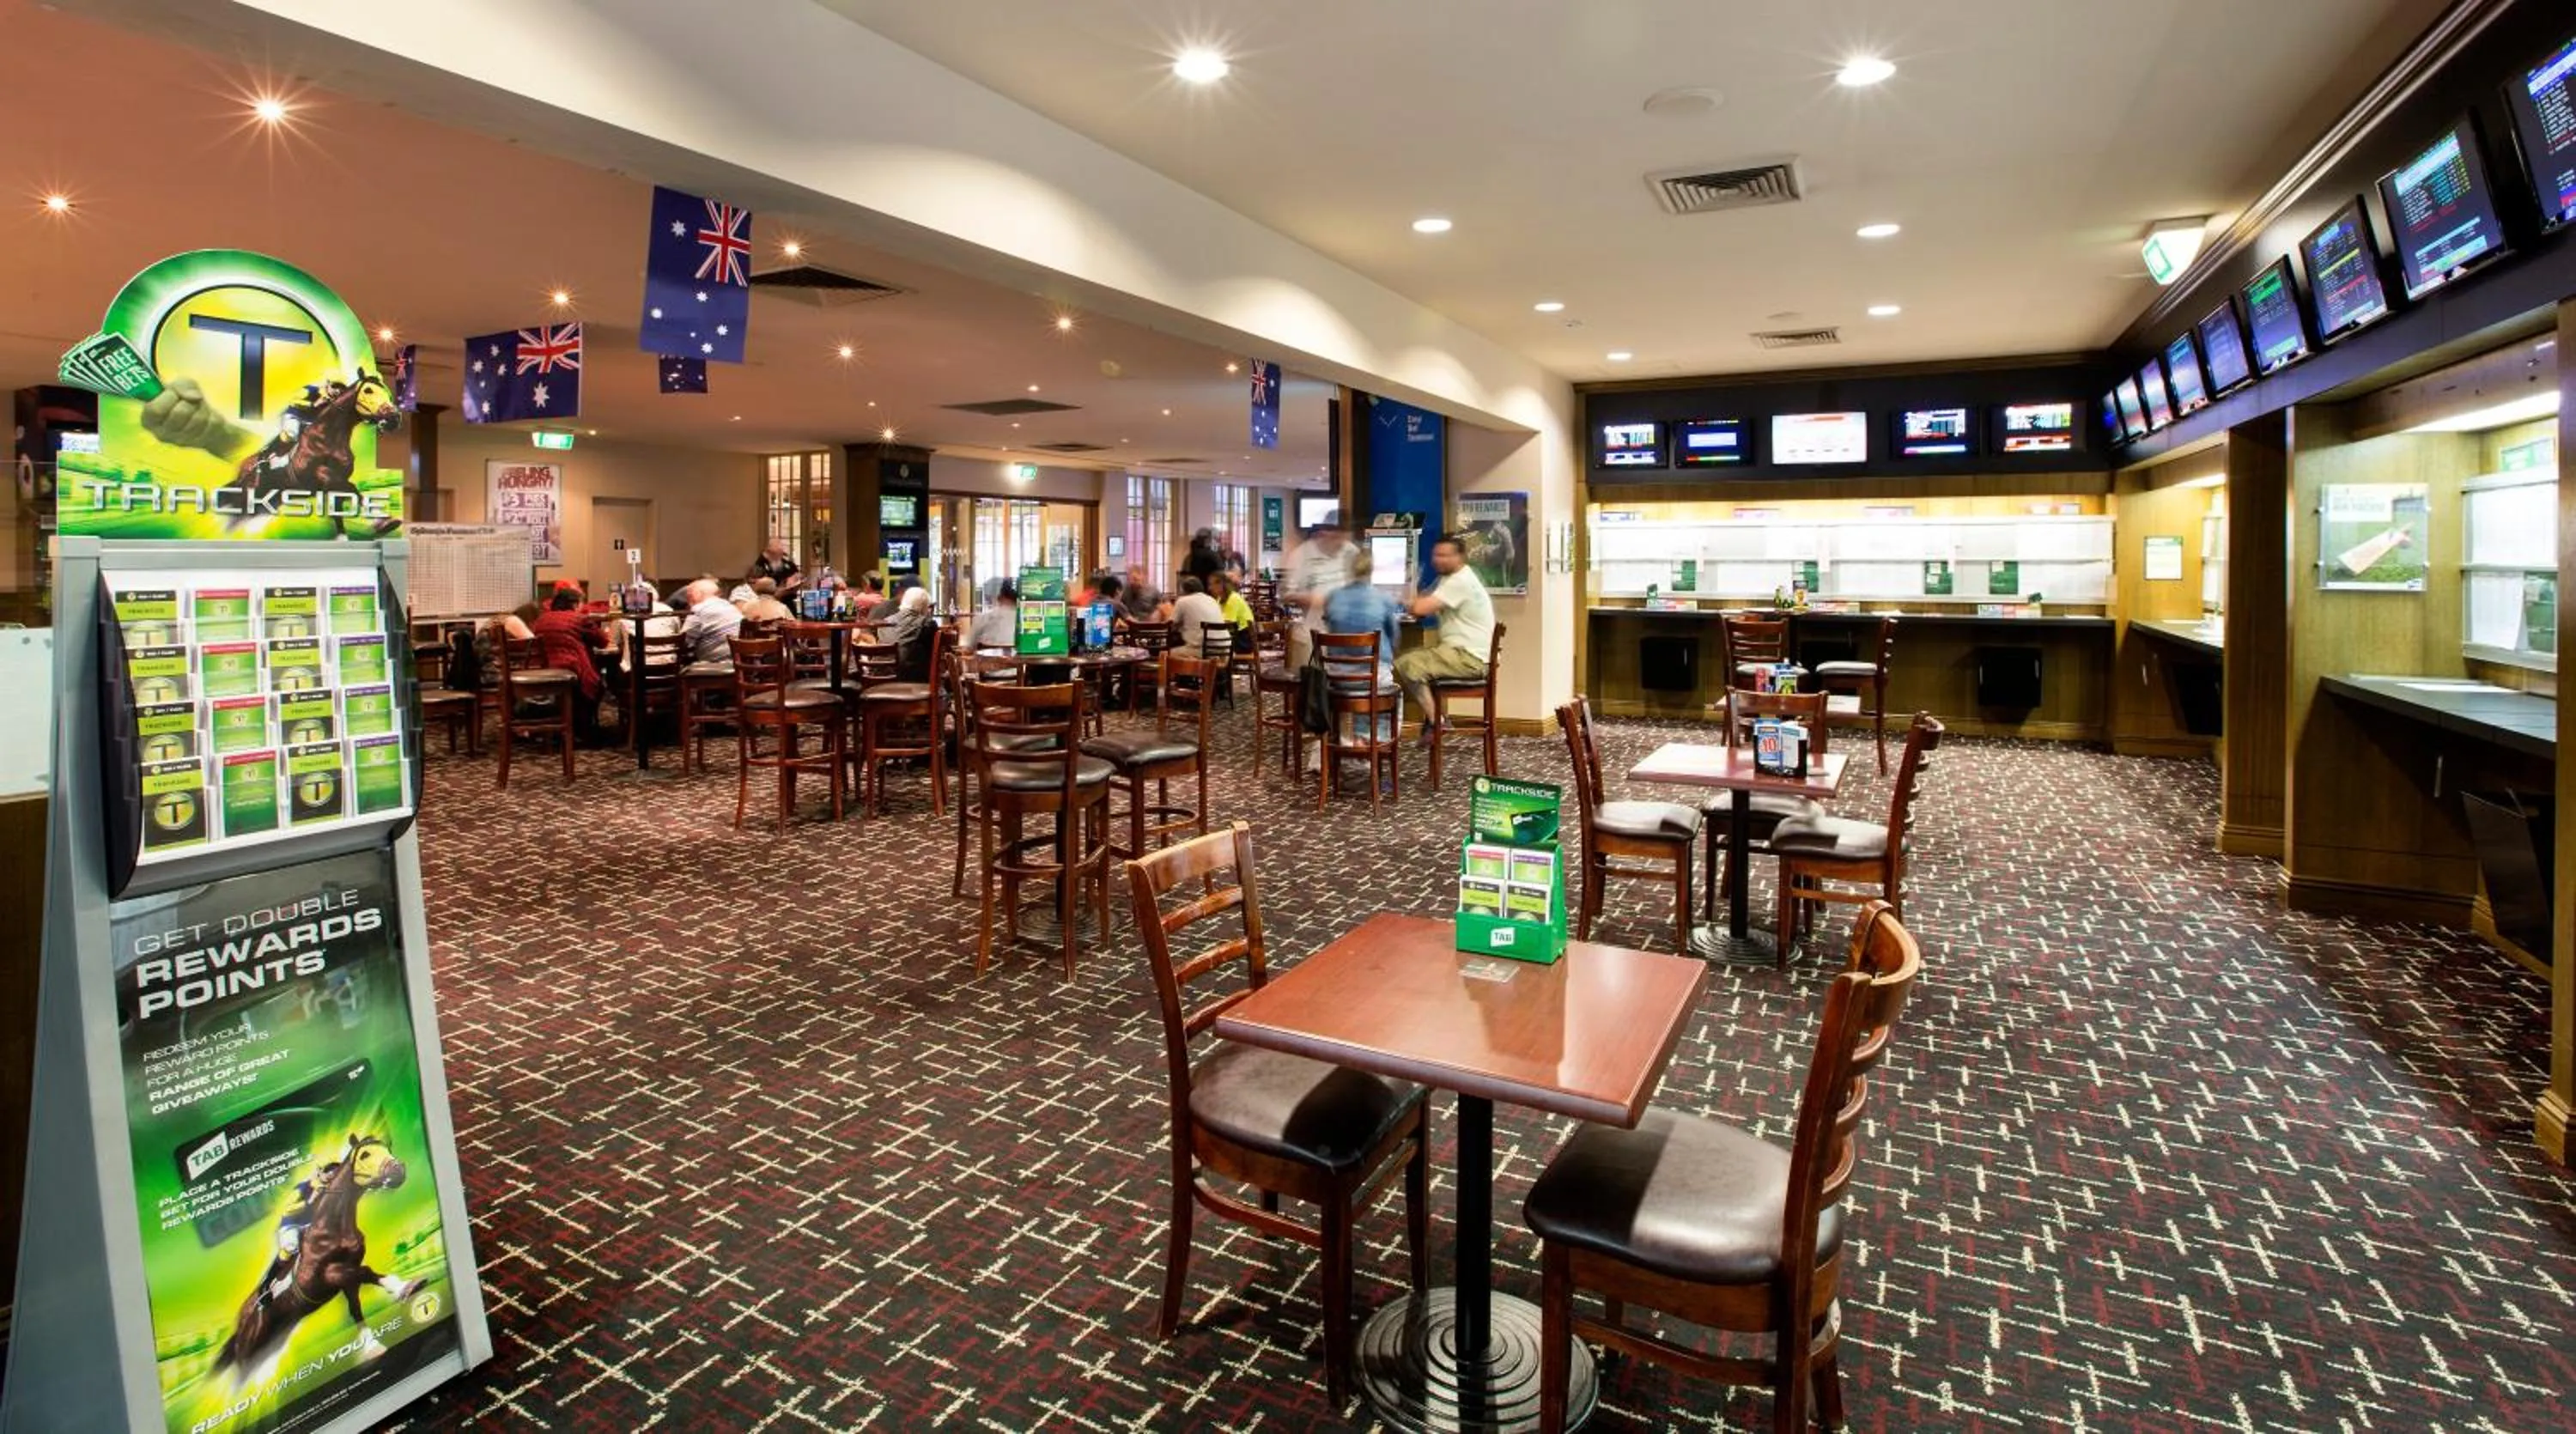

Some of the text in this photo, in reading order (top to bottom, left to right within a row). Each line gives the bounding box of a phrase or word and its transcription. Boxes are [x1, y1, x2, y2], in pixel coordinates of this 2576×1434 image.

[97, 345, 138, 376] FREE
[113, 365, 151, 392] BETS
[190, 313, 313, 421] T
[82, 480, 393, 520] TRACKSIDE
[1491, 782, 1556, 799] TRACKSIDE
[134, 889, 361, 956] GET DOUBLE
[1494, 932, 1512, 942] TAB
[137, 908, 383, 988] REWARDS
[143, 1023, 252, 1062] REDEEM YOUR
[145, 1030, 269, 1075] REWARD POINTS
[147, 1053, 238, 1088] FOR A HUGE
[149, 1048, 290, 1102] RANGE OF GREAT
[191, 1119, 276, 1167] TAB REWARDS
[159, 1147, 301, 1207] PLACE A TRACKSIDE
[161, 1153, 313, 1218] BET FOR YOUR DOUBLE
[161, 1196, 234, 1230] REWARDS
[191, 1392, 261, 1434] READY
[267, 1358, 325, 1396] WHEN
[328, 1336, 370, 1362] YOU
[370, 1316, 403, 1340] ARE
